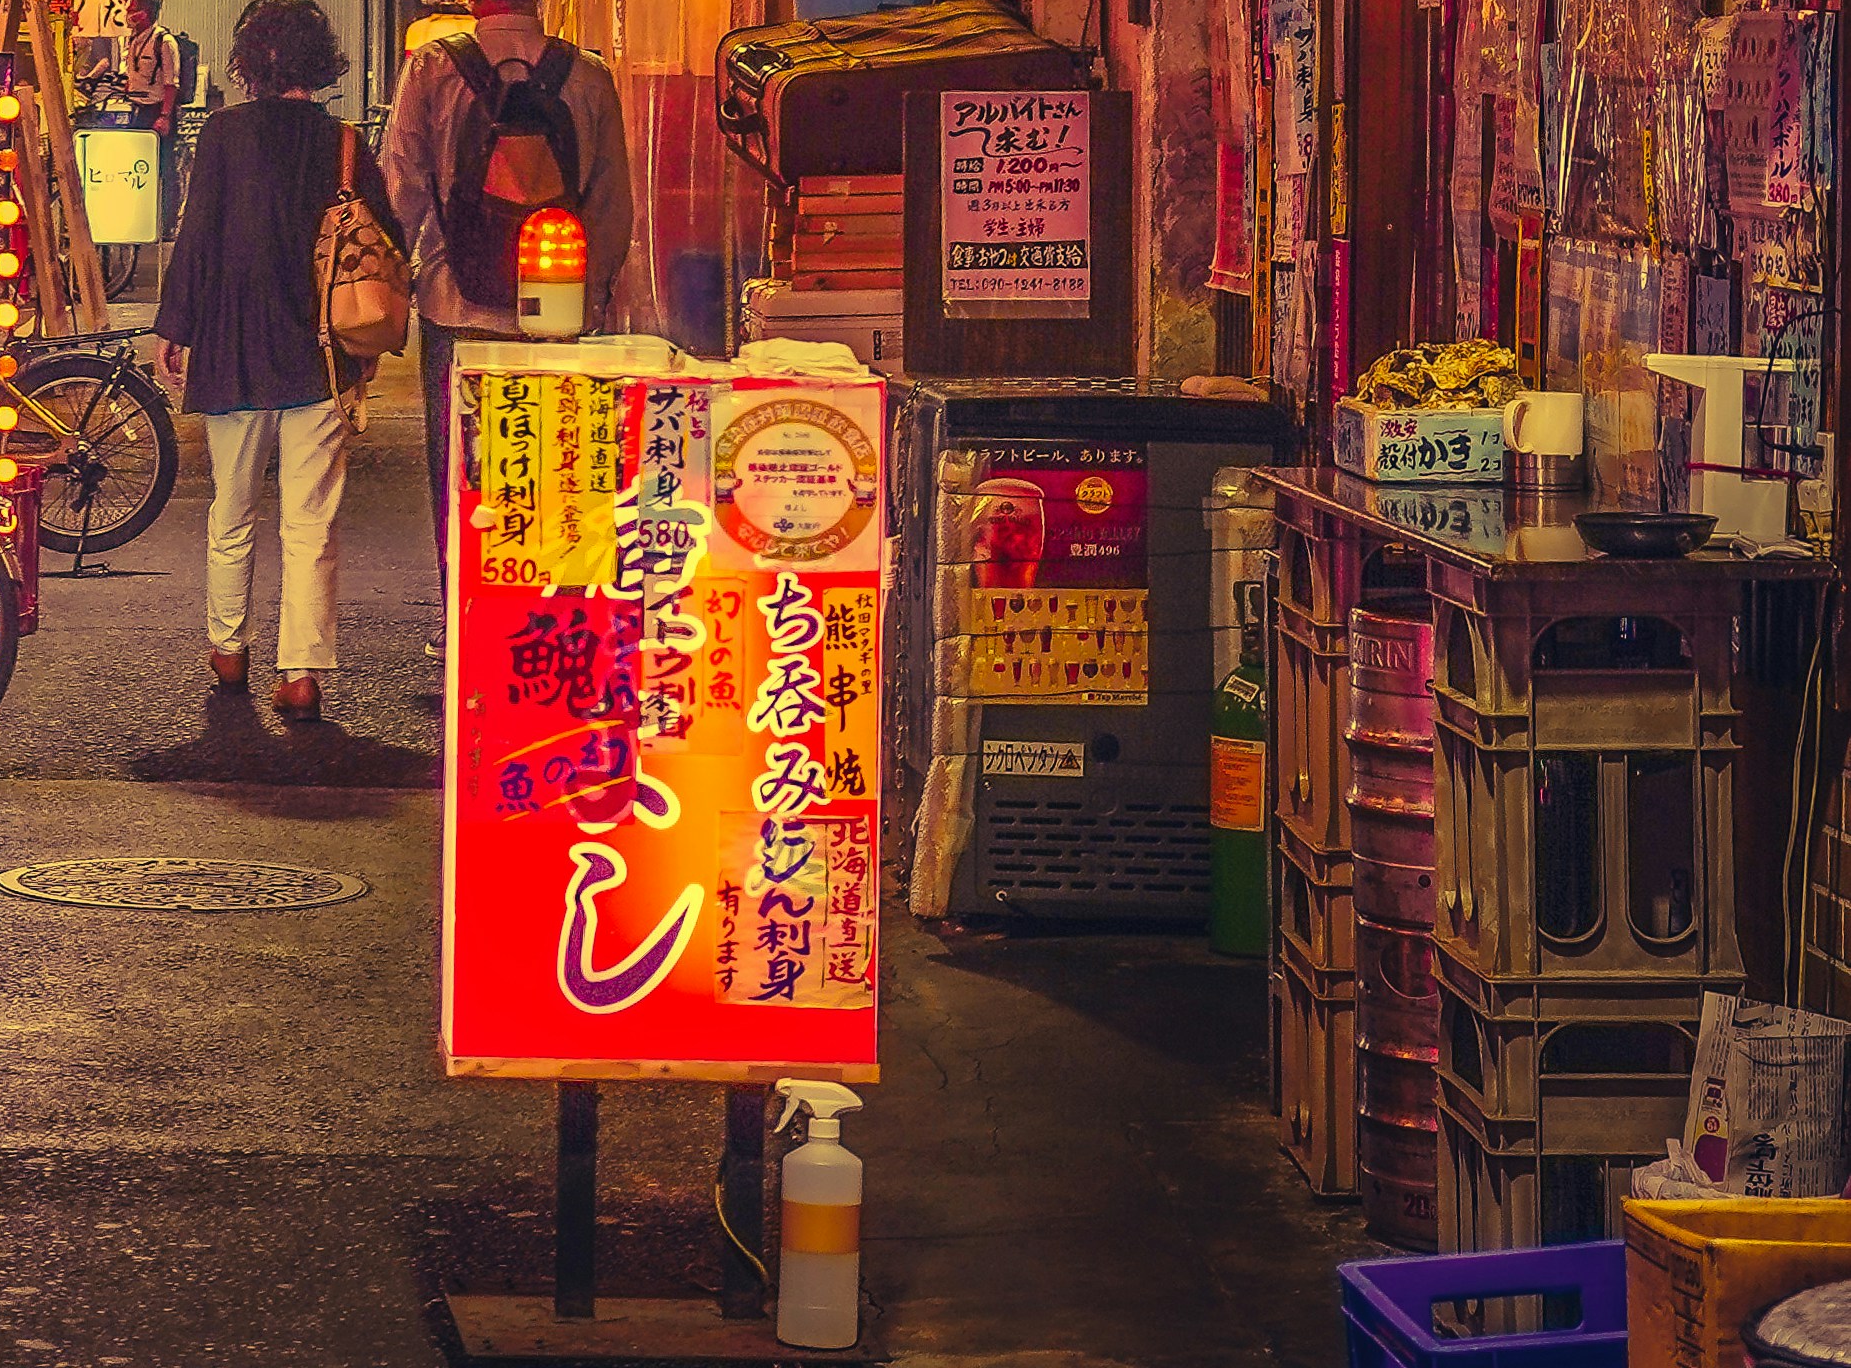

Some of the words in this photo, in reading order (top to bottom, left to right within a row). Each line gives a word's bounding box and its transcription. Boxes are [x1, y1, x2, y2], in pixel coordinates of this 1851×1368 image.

[952, 97, 1083, 127] アルバイトさん
[489, 375, 541, 547] 真ほっけ刺身
[644, 385, 686, 509] サバ刺身
[825, 603, 867, 797] 熊串焼
[714, 880, 743, 994] 有ります
[748, 817, 815, 1002] にしん刺身
[825, 819, 870, 983] 北海道直送
